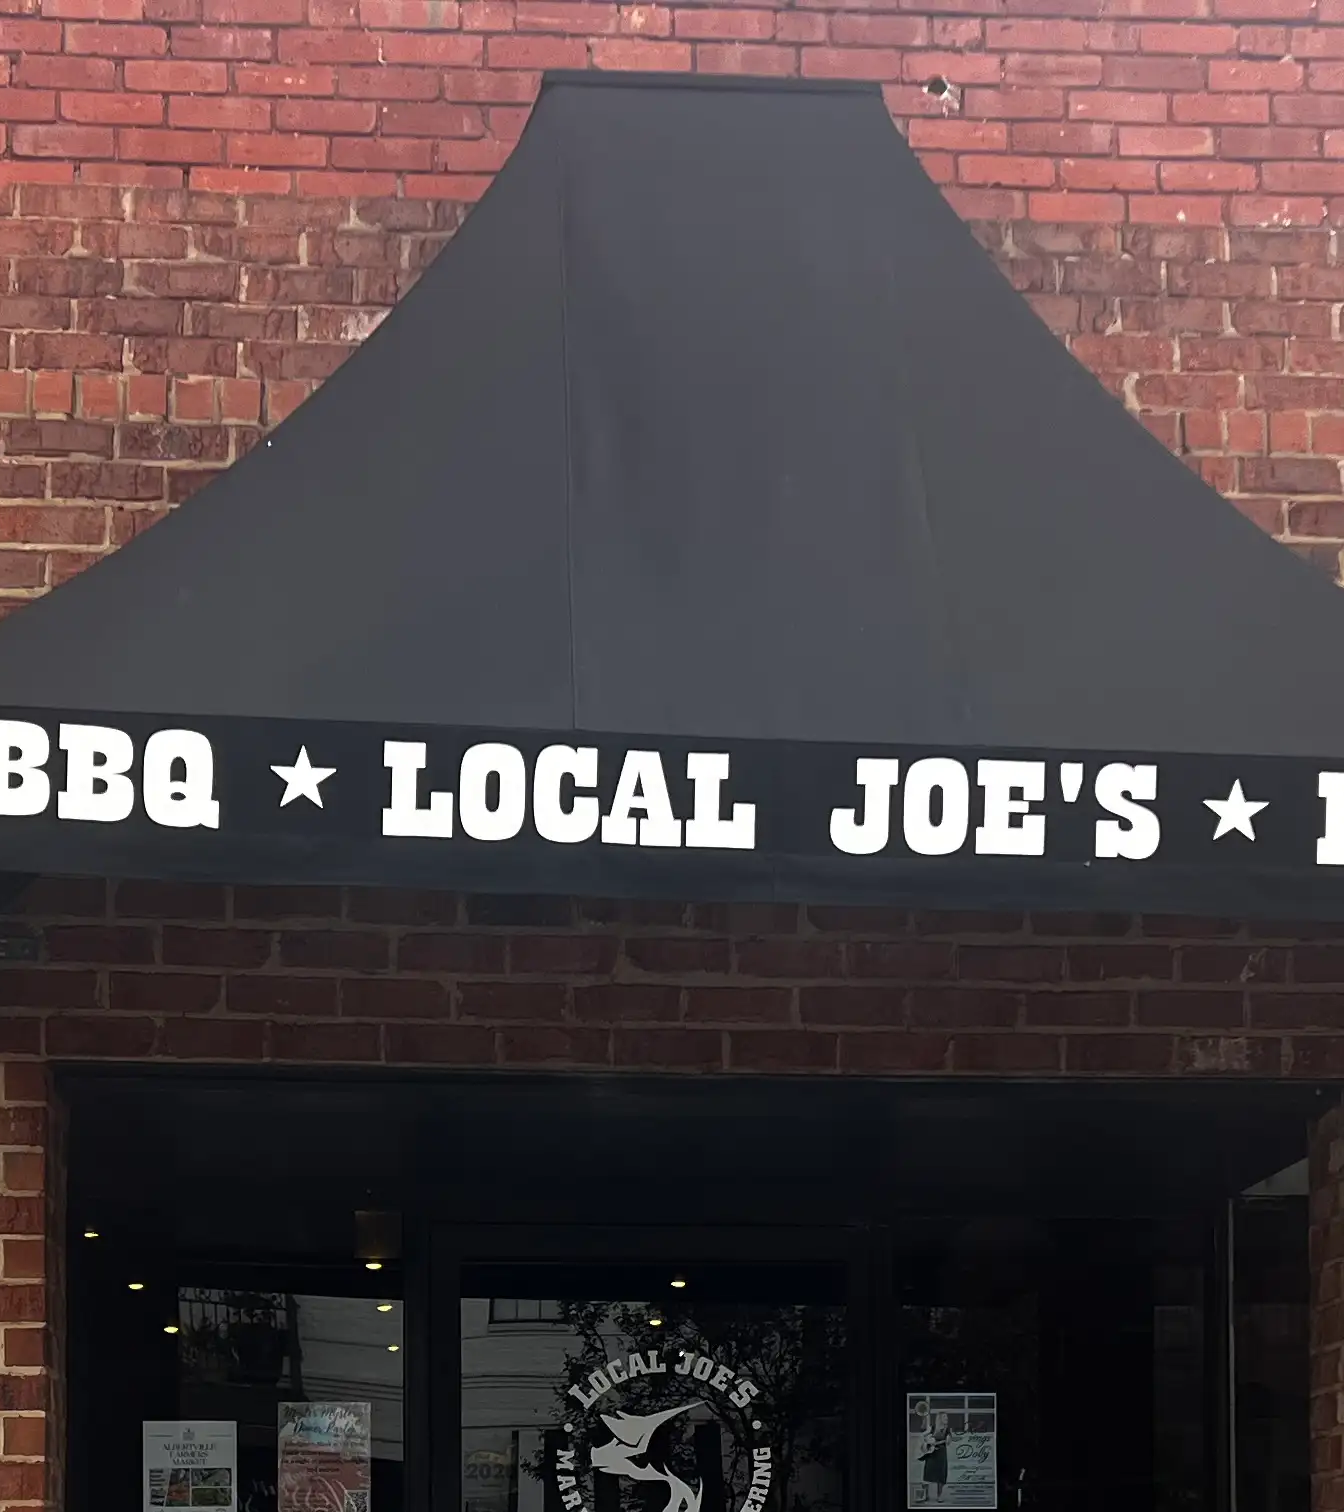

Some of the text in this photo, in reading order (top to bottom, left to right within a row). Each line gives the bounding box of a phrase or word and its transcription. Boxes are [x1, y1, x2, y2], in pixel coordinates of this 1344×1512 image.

[382, 740, 756, 850] LOCAL
[828, 757, 1161, 860] JOE'S
[567, 1349, 760, 1410] LOCAL JOE'S
